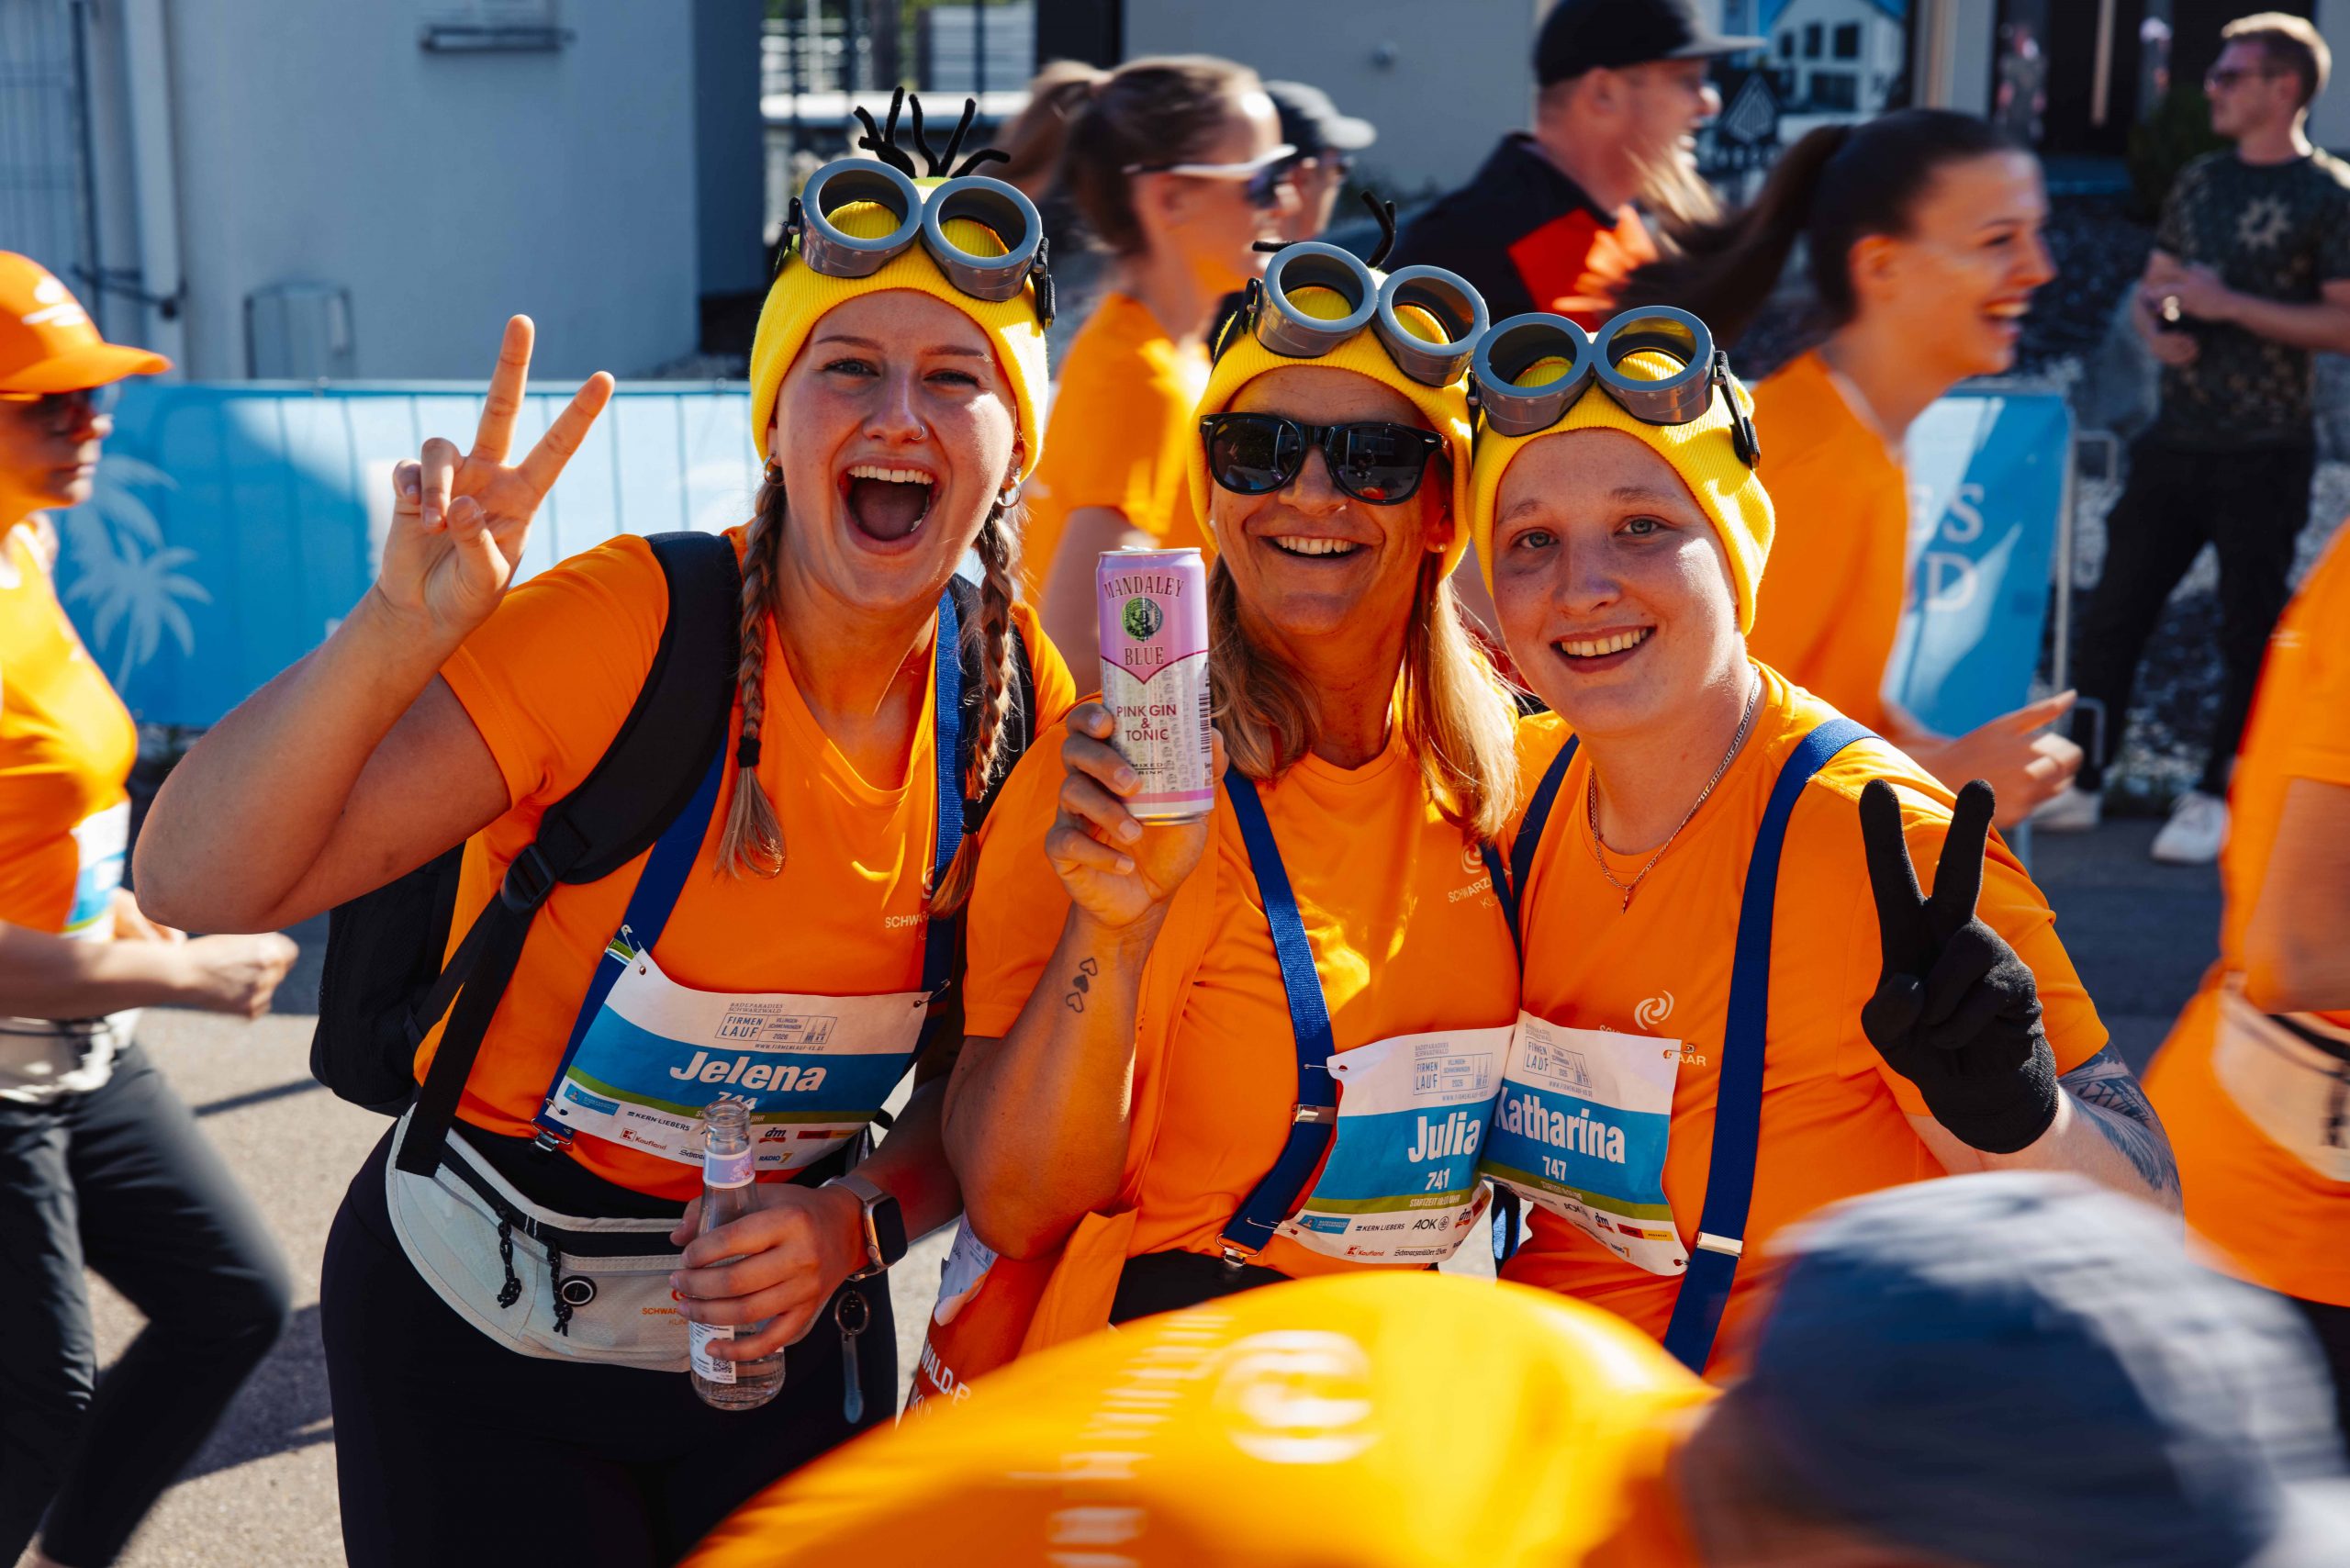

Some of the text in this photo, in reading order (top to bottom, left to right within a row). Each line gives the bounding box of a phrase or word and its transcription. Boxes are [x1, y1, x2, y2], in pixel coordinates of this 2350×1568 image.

[1103, 576, 1184, 599] MANDALEY
[1125, 646, 1164, 666] BLUE
[1116, 704, 1177, 717] PINK GIN
[1141, 717, 1151, 729] &
[1125, 728, 1169, 741] TONIC
[727, 1016, 764, 1025] FIRMEN
[722, 1025, 759, 1038] LAUF
[1416, 1061, 1438, 1072] FIRMEN
[1527, 1054, 1549, 1071] LAUF
[670, 1051, 827, 1092] Jelena
[1416, 1073, 1438, 1091] LAUF
[765, 1126, 787, 1138] dm
[1494, 1087, 1626, 1164] Katharina
[635, 1135, 667, 1150] Kaufland
[1407, 1111, 1481, 1163] Julia
[1542, 1155, 1567, 1181] 747
[1425, 1168, 1450, 1191] 741
[1459, 1208, 1472, 1221] dm
[1595, 1212, 1610, 1226] dm
[1413, 1218, 1438, 1230] AOK
